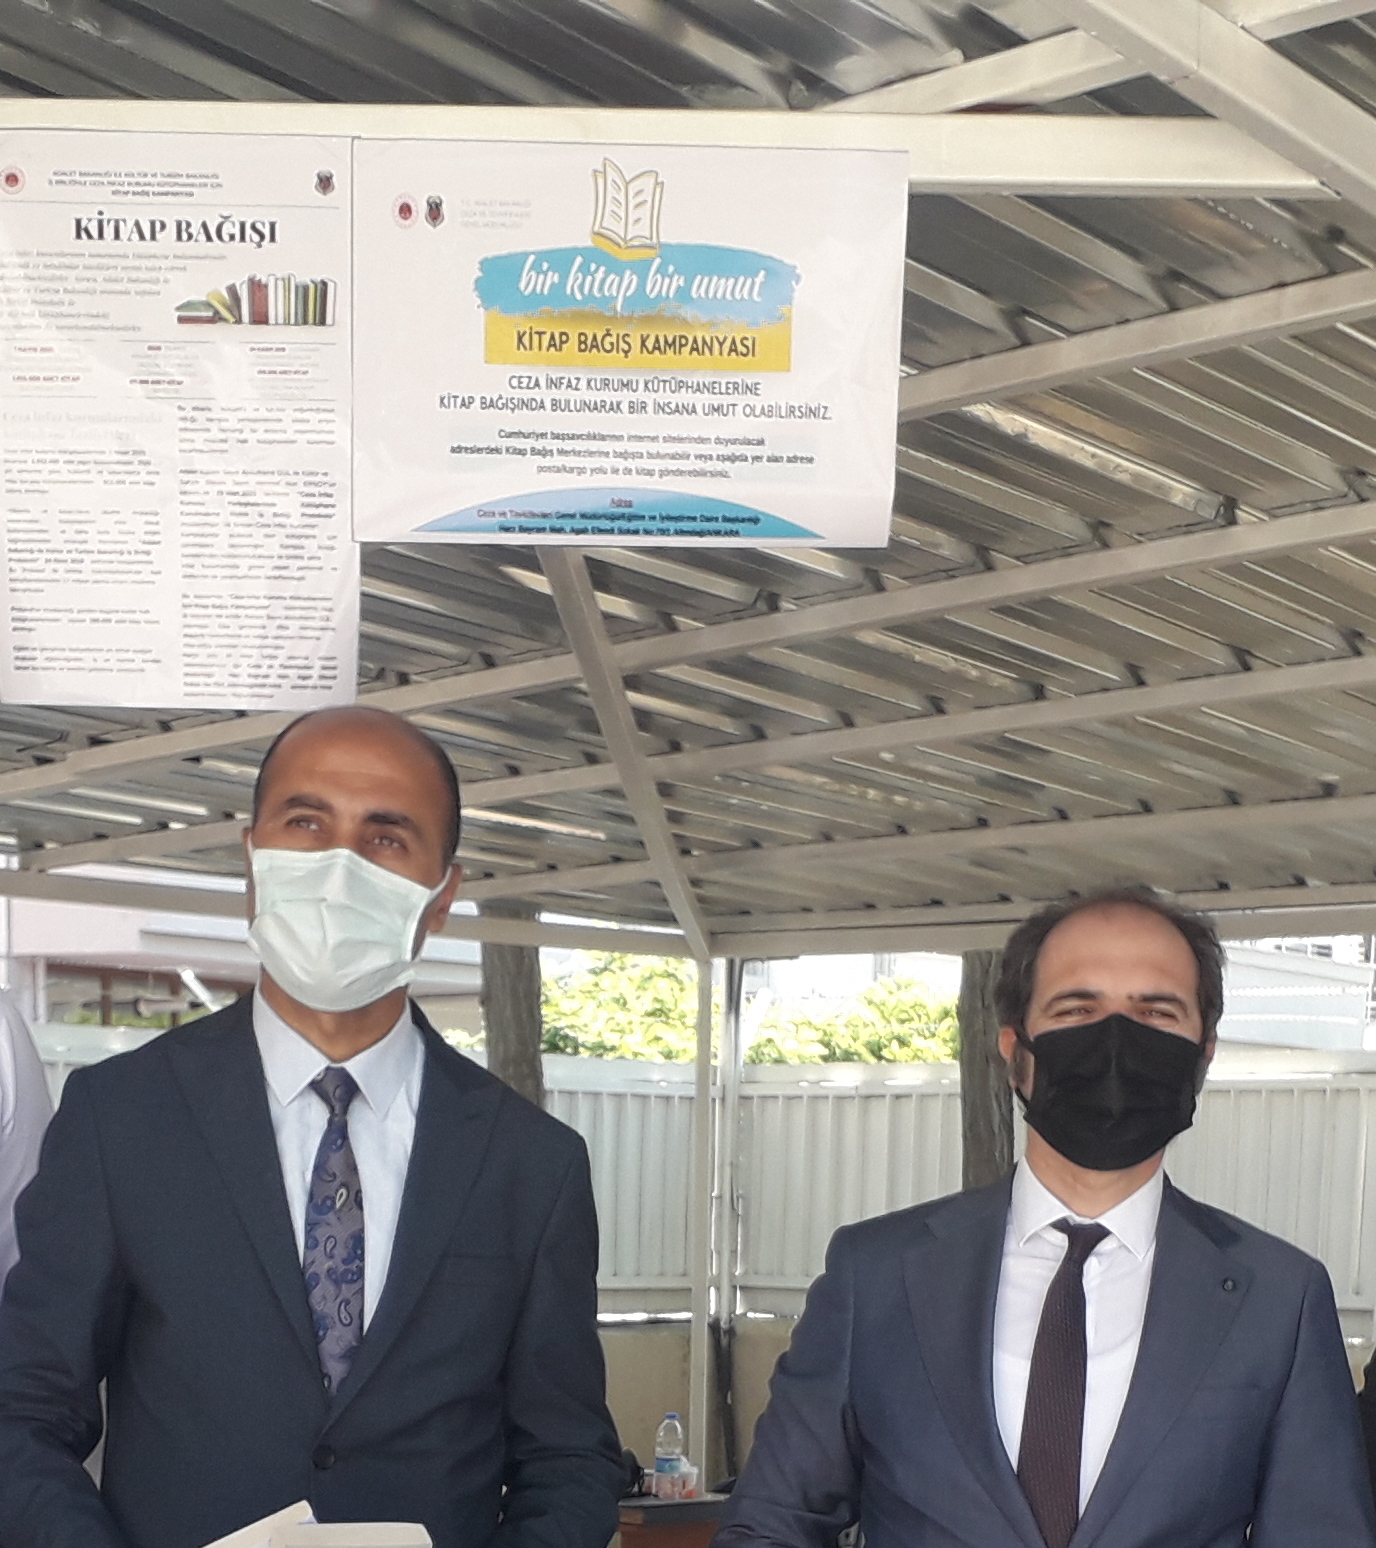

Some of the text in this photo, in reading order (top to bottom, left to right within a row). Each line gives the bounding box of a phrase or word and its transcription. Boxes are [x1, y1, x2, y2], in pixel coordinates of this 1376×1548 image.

[74, 209, 278, 249] KİTAP BAĞIŞI
[520, 254, 766, 311] bir kitap bir umut
[516, 325, 756, 359] KİTAP BAĞIŞ KAMPANYASI
[508, 372, 762, 397] CEZA İNFAZ KURUMU KÜTÜPHANELERİNE
[439, 392, 832, 421] KİTAP BAĞIŞINDA BULUNARAK BİR İNSANA UMUT OLABİLİRSİNİZ.
